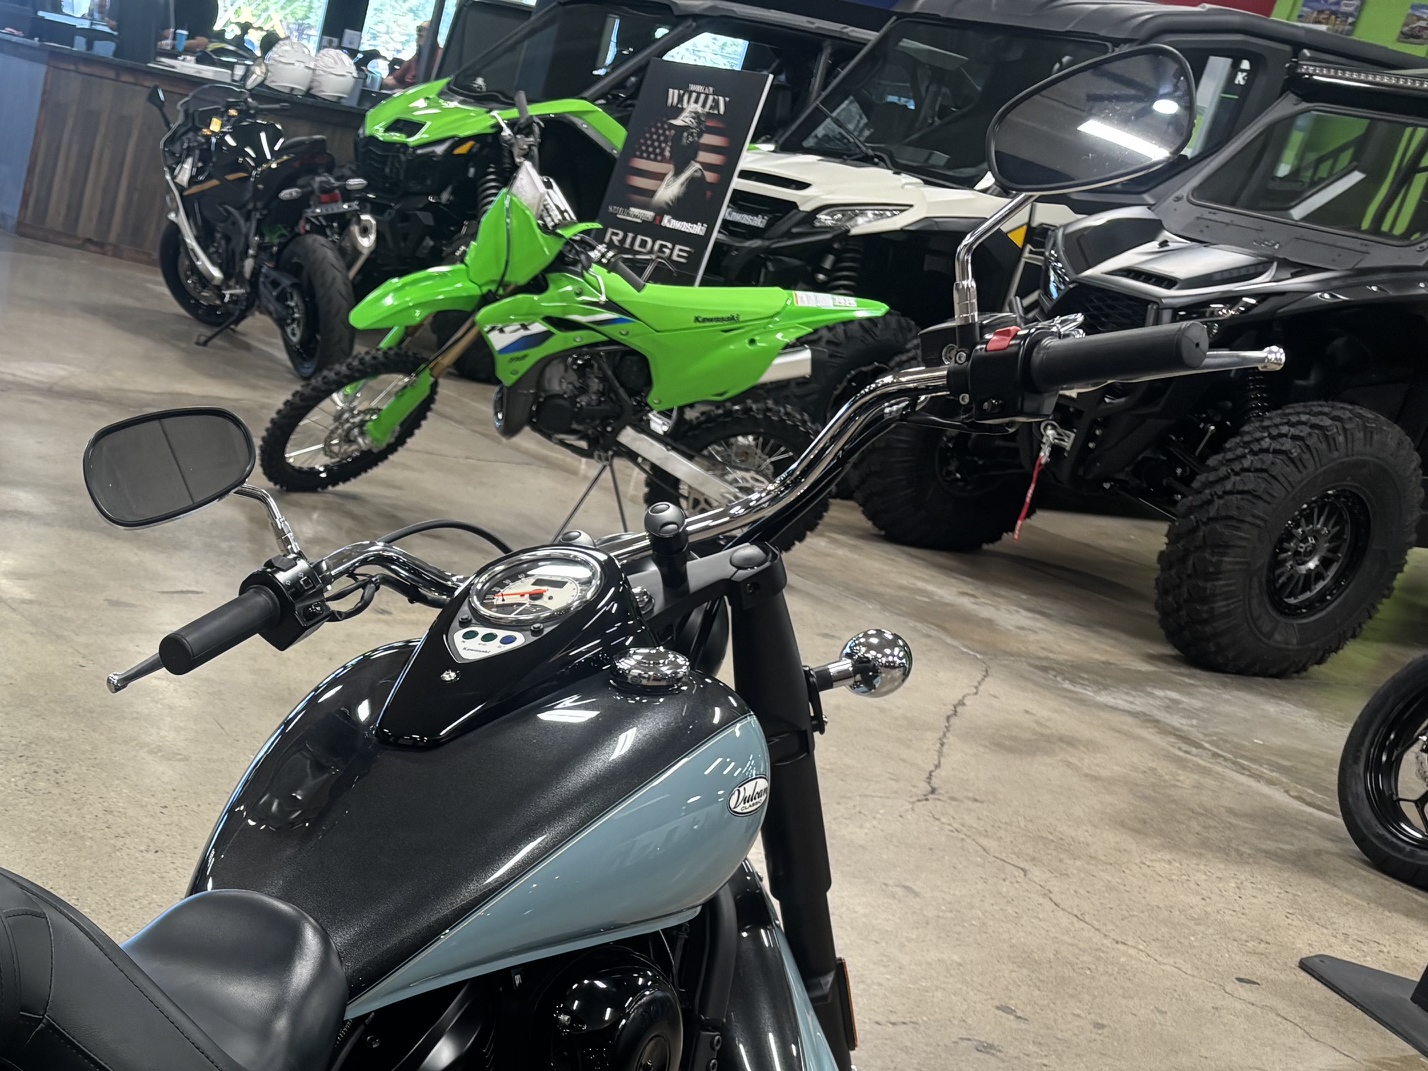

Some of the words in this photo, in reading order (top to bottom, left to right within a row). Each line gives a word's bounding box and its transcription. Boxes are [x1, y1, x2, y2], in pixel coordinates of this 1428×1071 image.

[661, 214, 708, 236] Kawasaki
[724, 208, 769, 228] Kawasaki
[604, 227, 692, 263] RIDGE
[693, 313, 740, 324] Kawasaki
[732, 781, 768, 809] Vulcan
